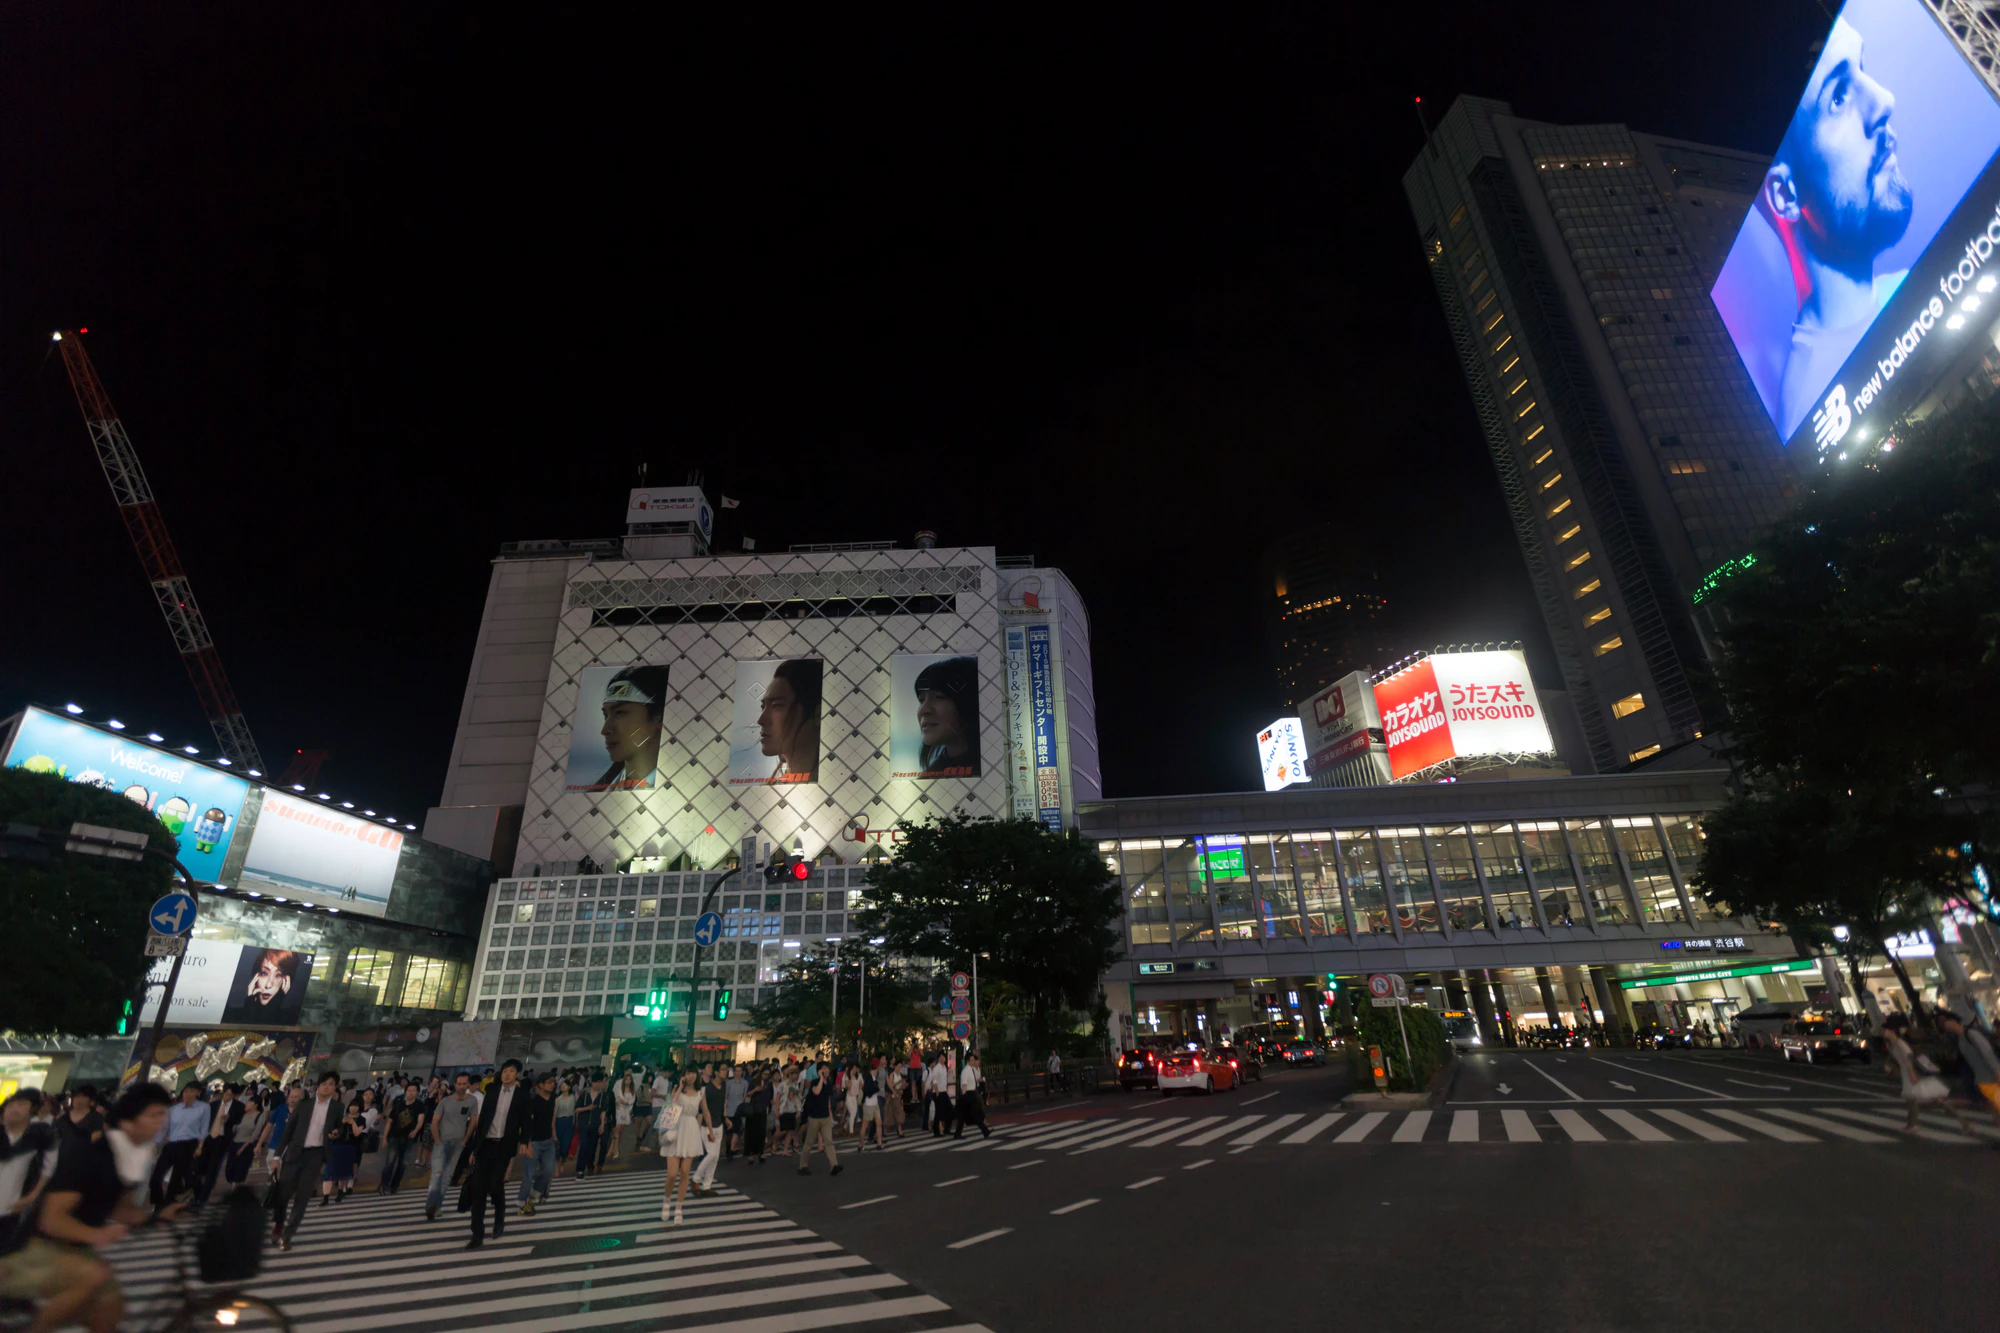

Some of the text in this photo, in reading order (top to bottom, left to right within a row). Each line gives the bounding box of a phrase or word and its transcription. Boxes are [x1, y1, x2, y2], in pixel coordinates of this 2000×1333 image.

[1853, 199, 2000, 415] new balance footba
[648, 503, 695, 511] TOKYU
[1449, 681, 1526, 706] うたスキ
[1383, 690, 1438, 733] カラオケ
[1452, 704, 1535, 722] JOYSOUND
[1388, 711, 1446, 749] JOYSOUND
[111, 745, 185, 785] Welcome!
[1661, 941, 1682, 949] KEIO
[1714, 937, 1746, 949] 渋谷駅
[170, 997, 185, 1006] on
[187, 996, 209, 1008] sale
